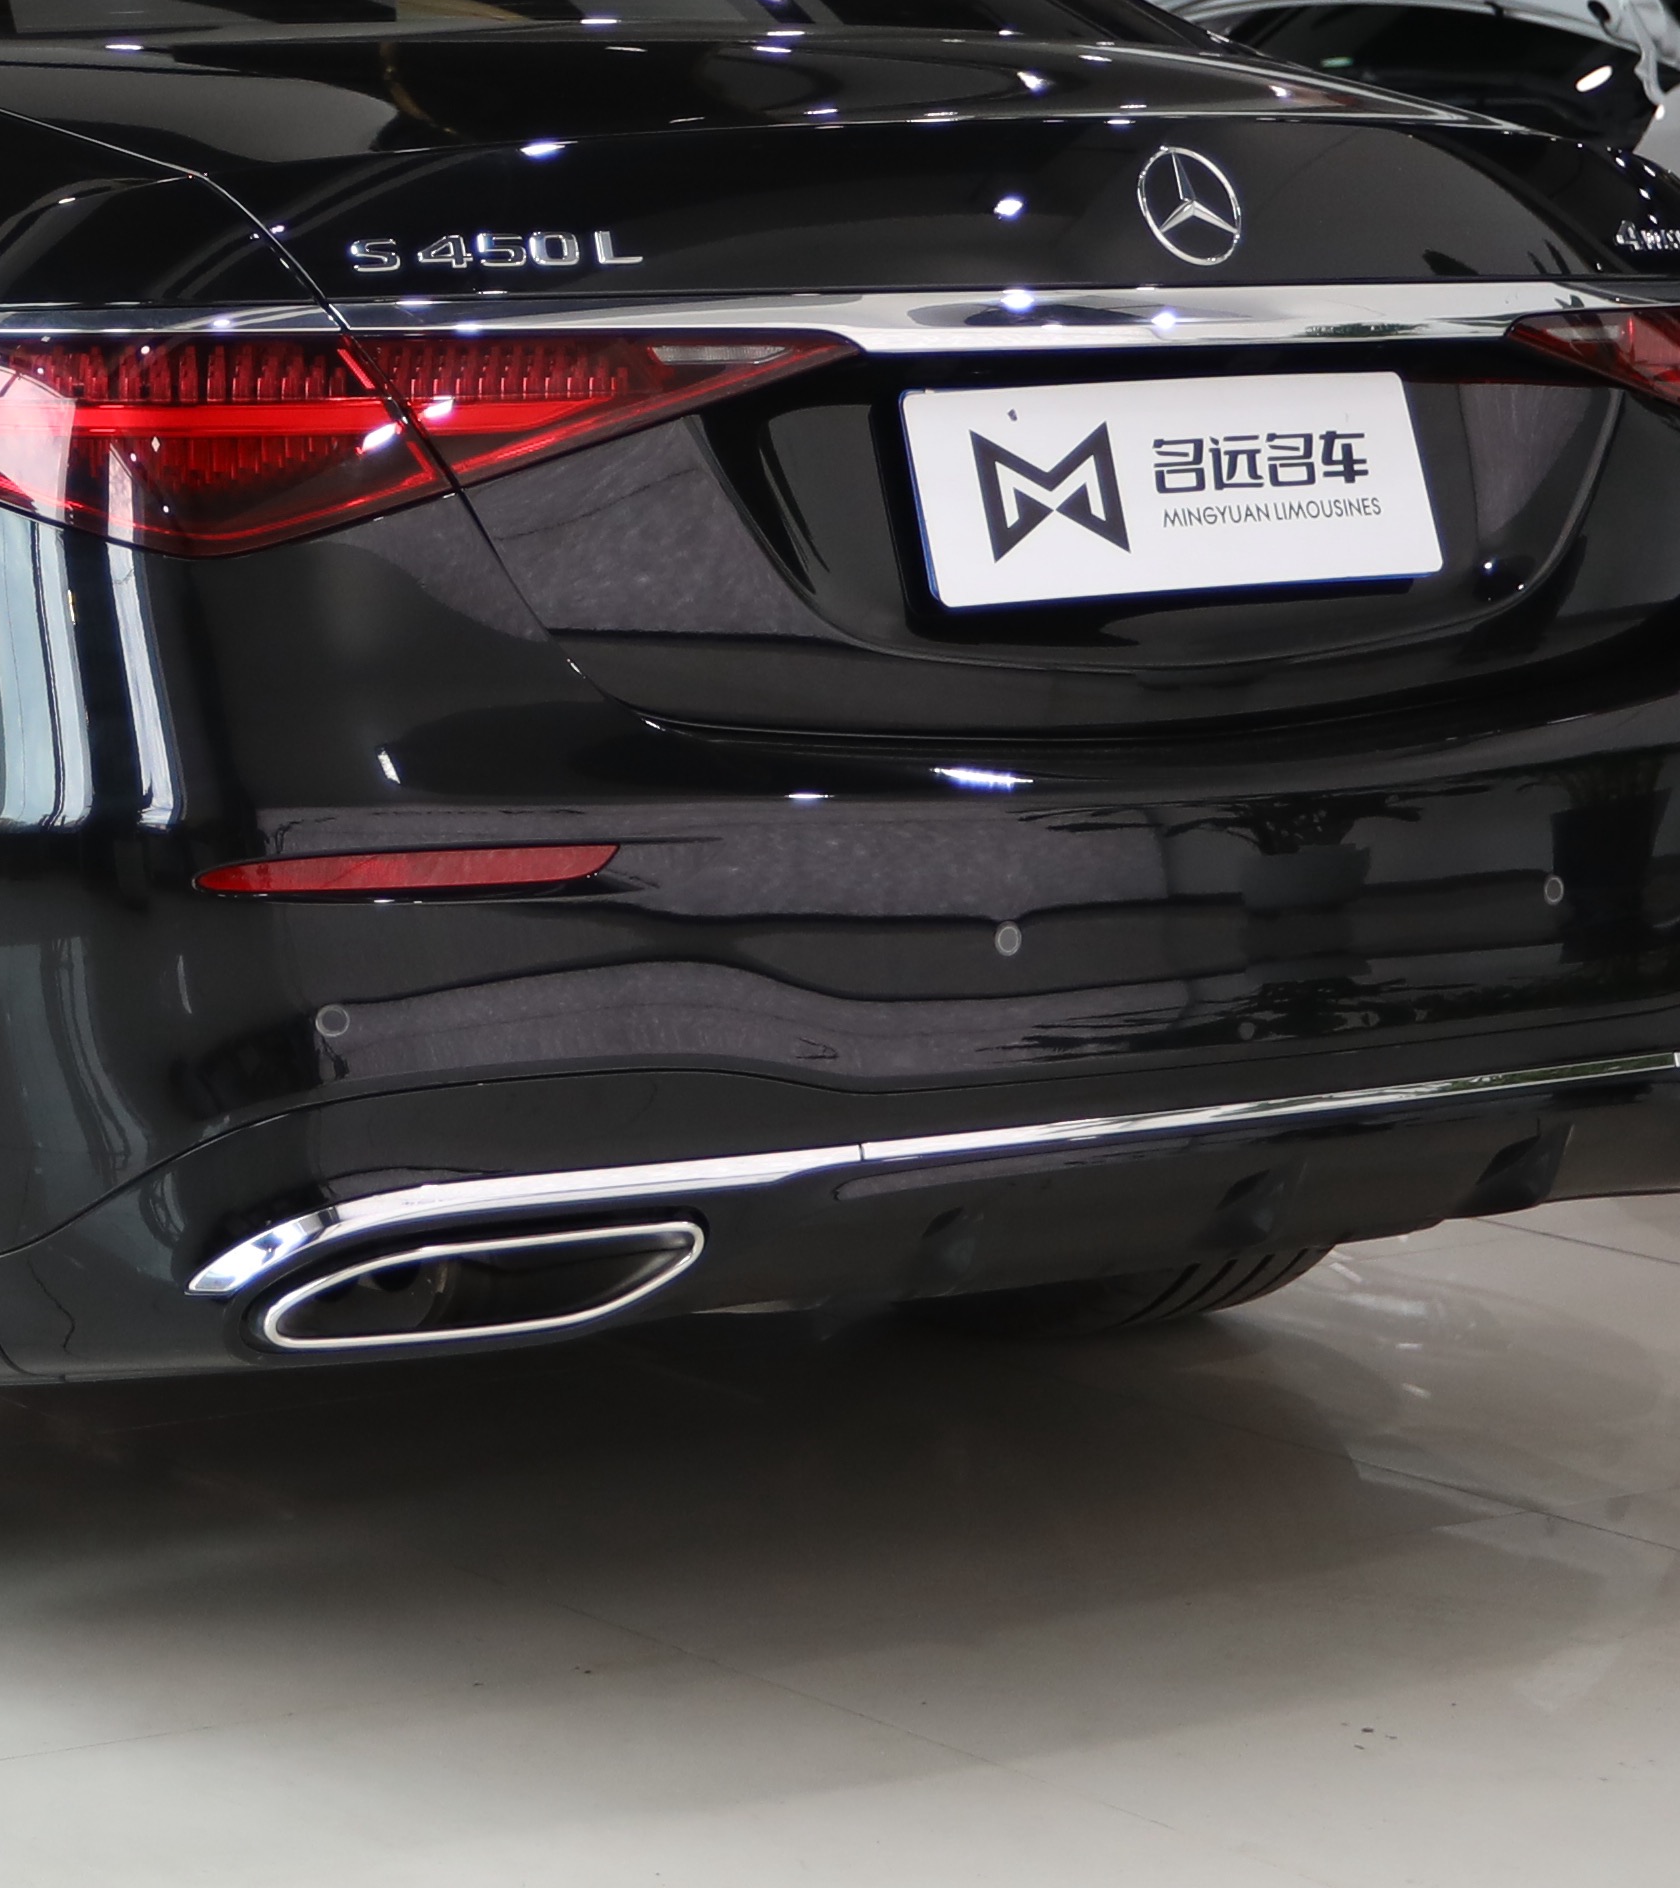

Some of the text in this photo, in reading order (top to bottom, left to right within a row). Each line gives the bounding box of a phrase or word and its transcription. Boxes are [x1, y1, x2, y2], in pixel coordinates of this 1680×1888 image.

[1152, 430, 1369, 494] 名远名车
[1163, 497, 1381, 528] MINGYUAN LIMOUSINES
